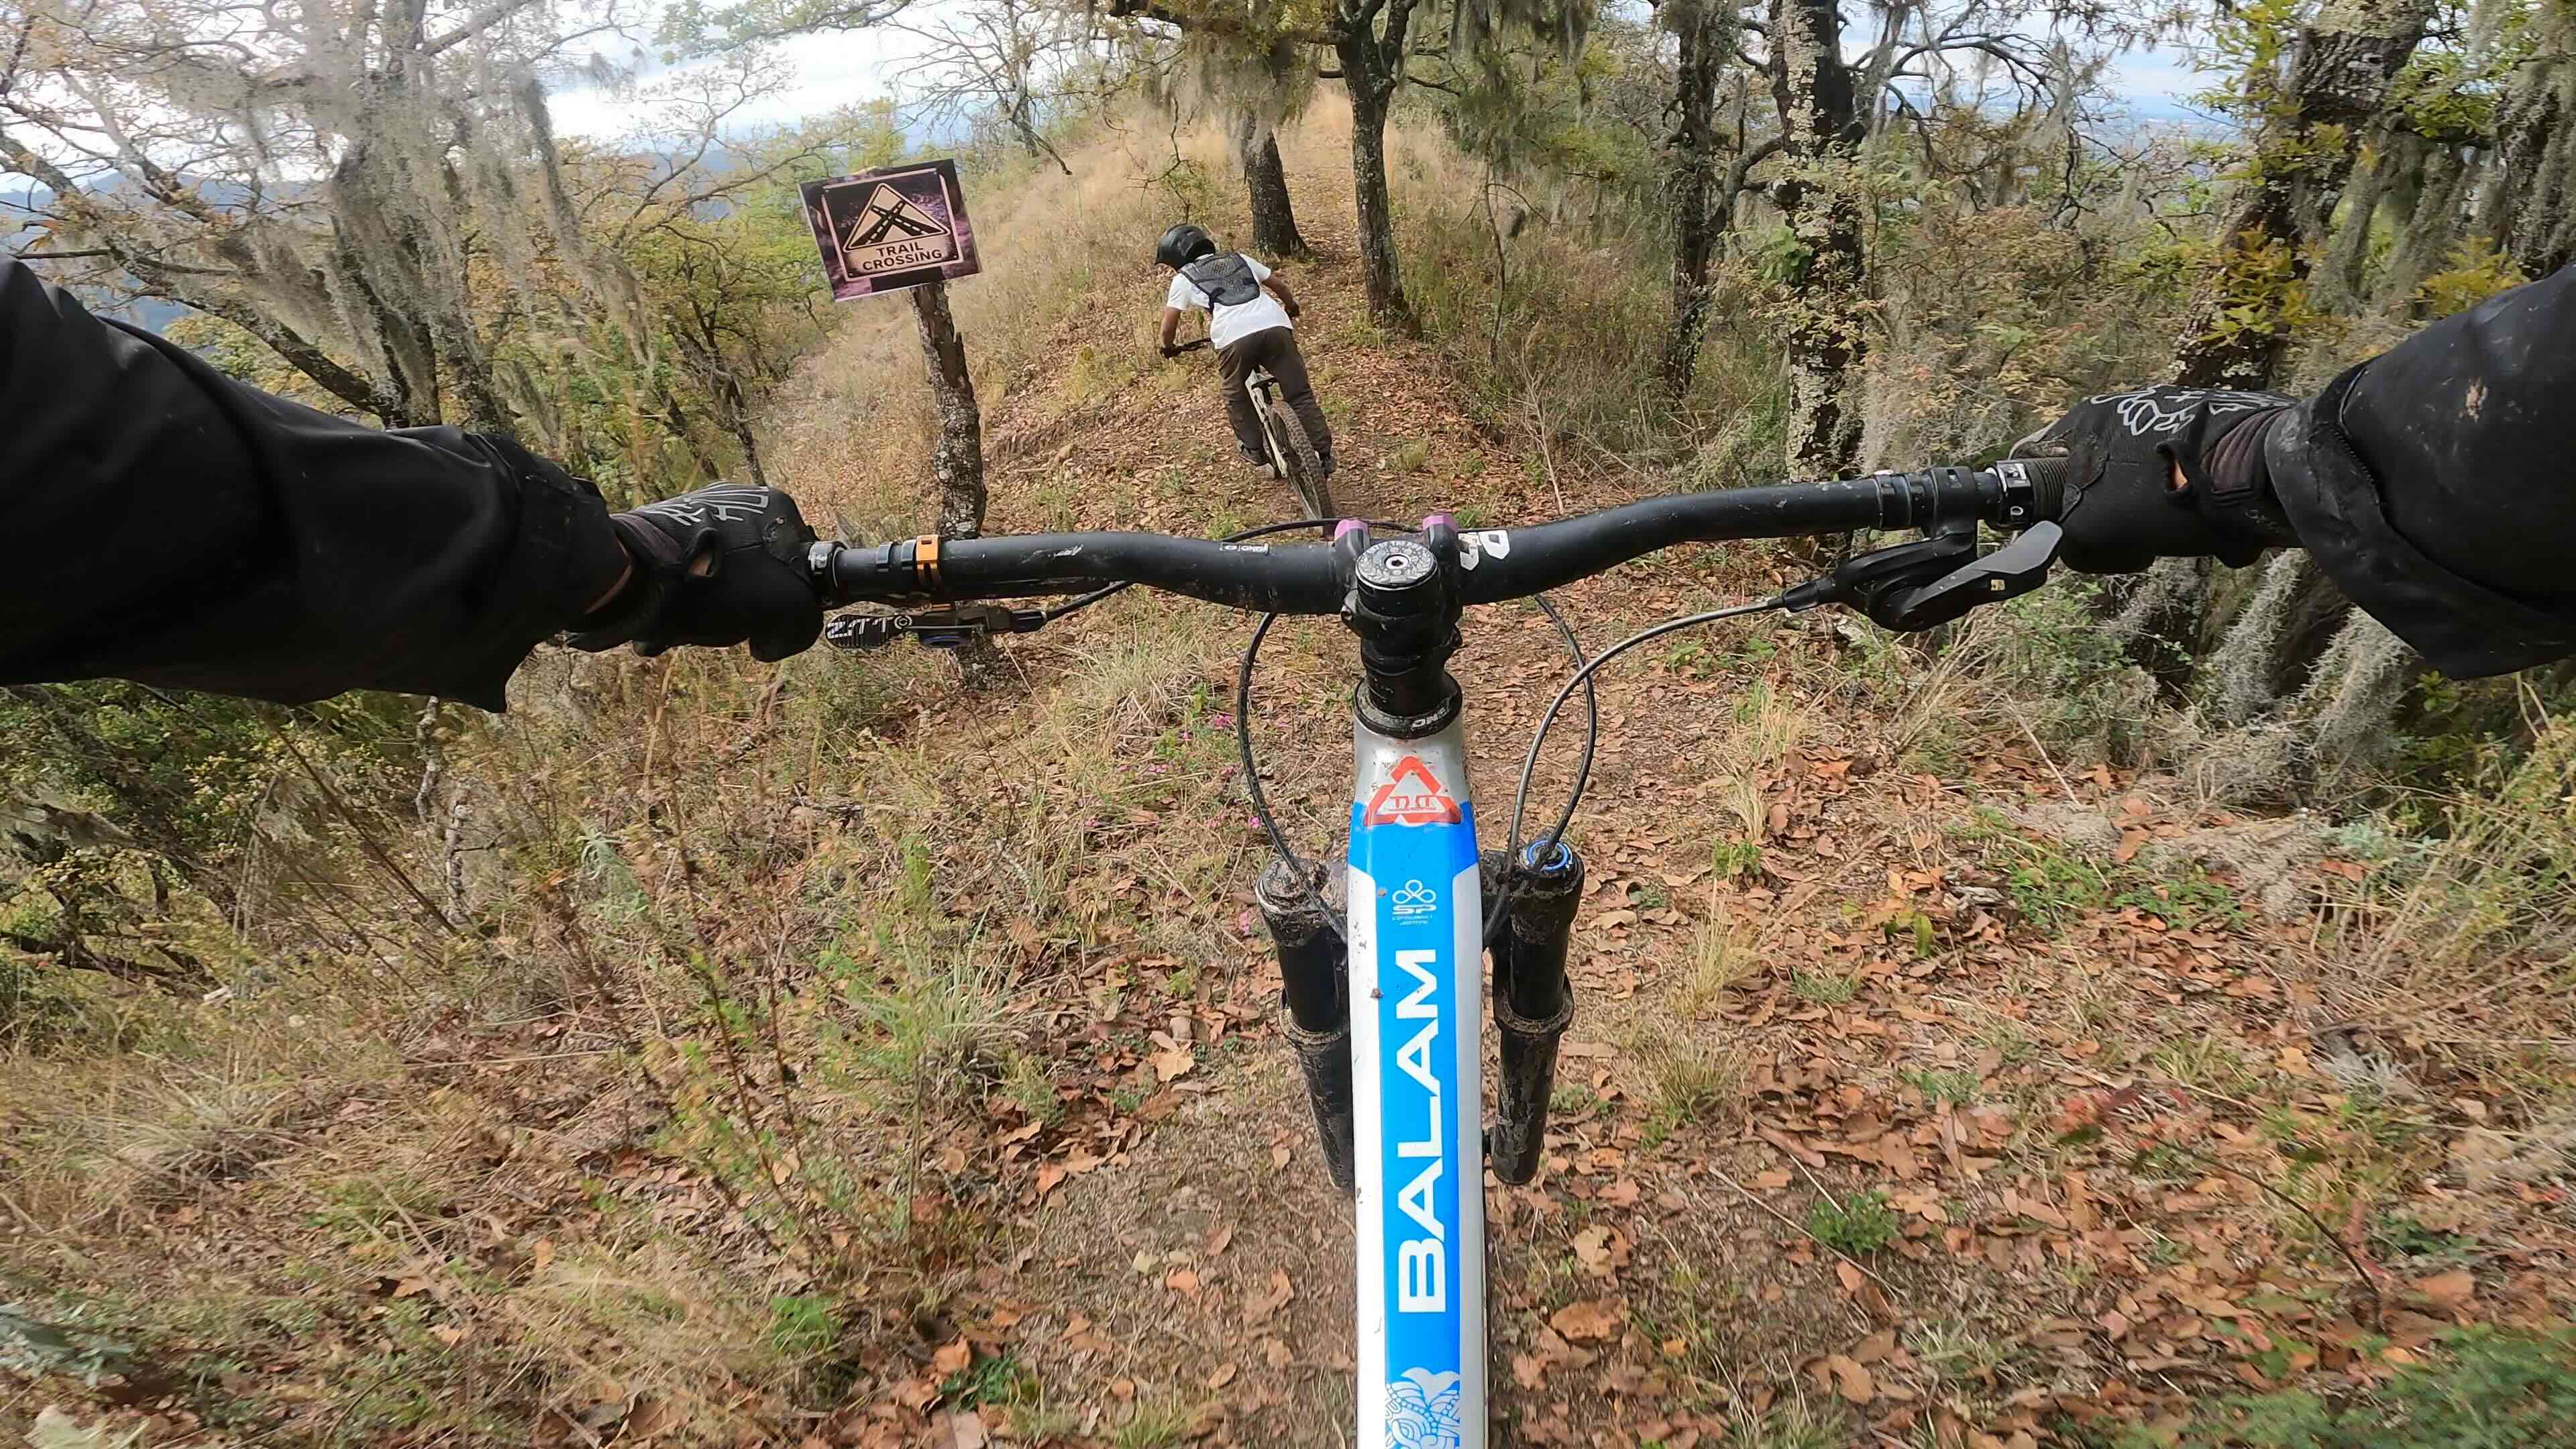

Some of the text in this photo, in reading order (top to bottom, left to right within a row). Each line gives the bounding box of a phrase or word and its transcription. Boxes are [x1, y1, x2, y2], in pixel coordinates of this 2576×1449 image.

[862, 249, 943, 271] CROSSING
[876, 241, 924, 257] TRAIL
[1395, 949, 1446, 1313] BALAM
